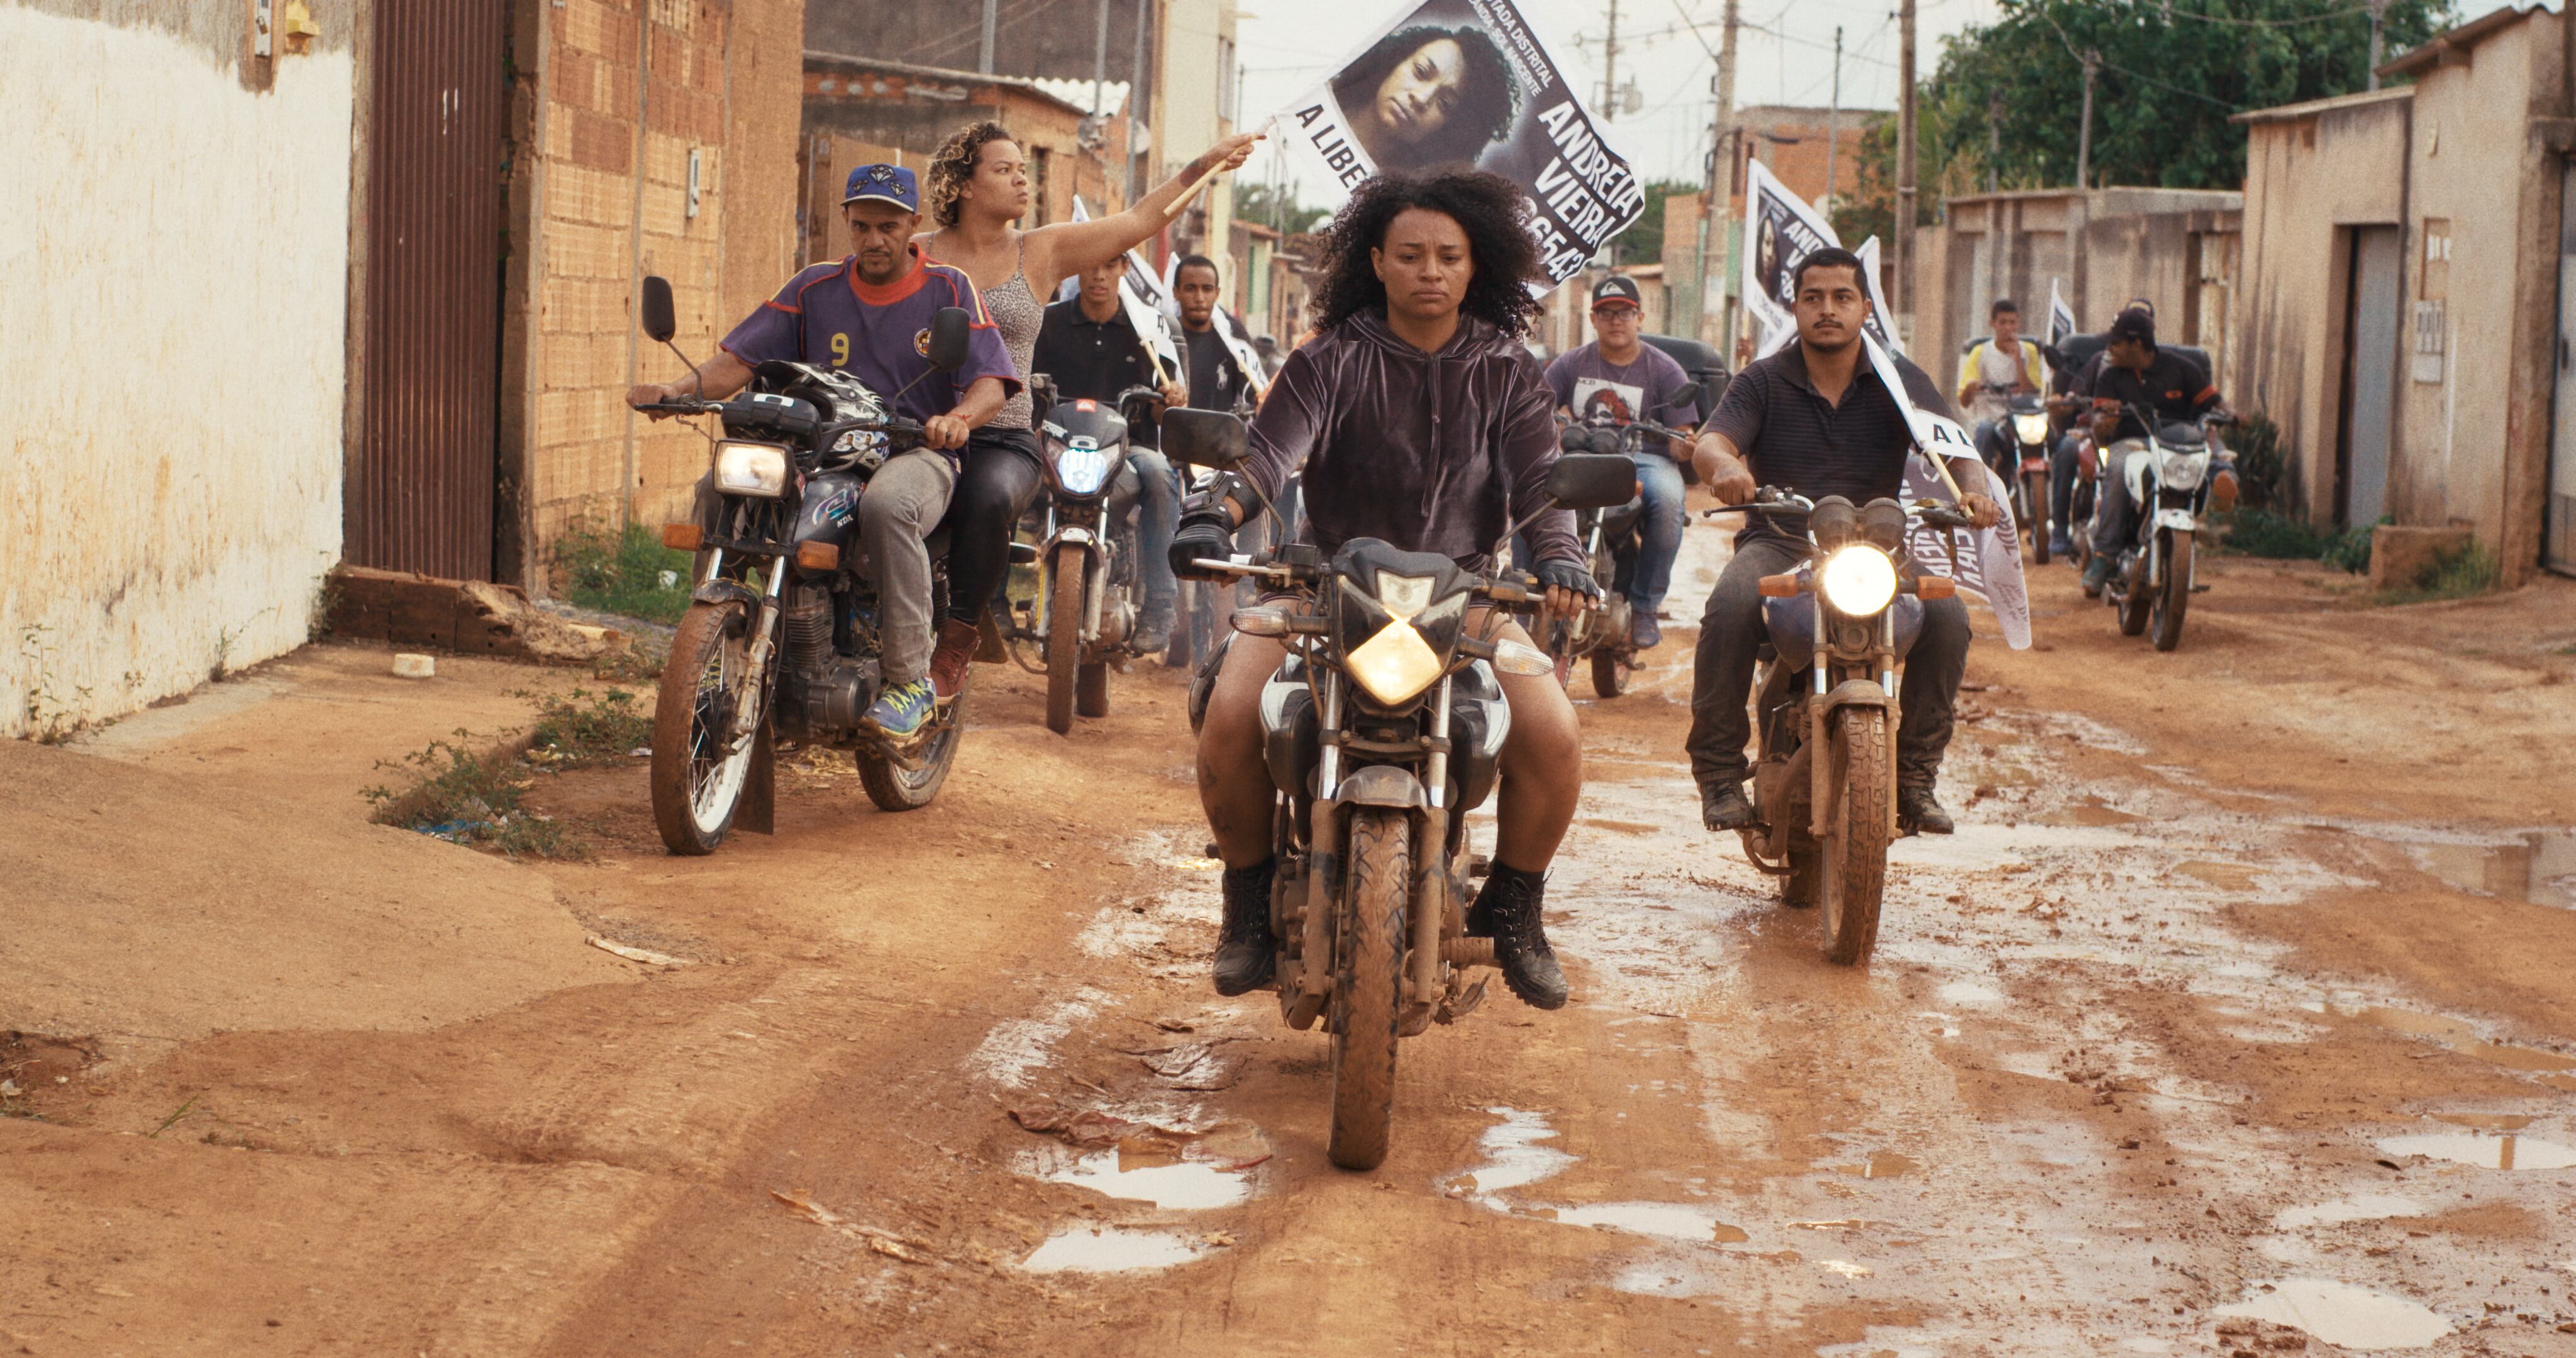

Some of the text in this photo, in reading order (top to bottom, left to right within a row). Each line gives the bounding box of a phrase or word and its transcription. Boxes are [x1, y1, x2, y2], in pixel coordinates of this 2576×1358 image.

[1504, 46, 1542, 97] NASCENTE
[1511, 27, 1553, 89] DISTRITAL
[1296, 104, 1367, 194] A LIBE
[1538, 101, 1641, 218] ANDREIA
[1535, 156, 1617, 248] VIEIRA
[831, 333, 849, 367] 9
[1933, 424, 1952, 444] A
